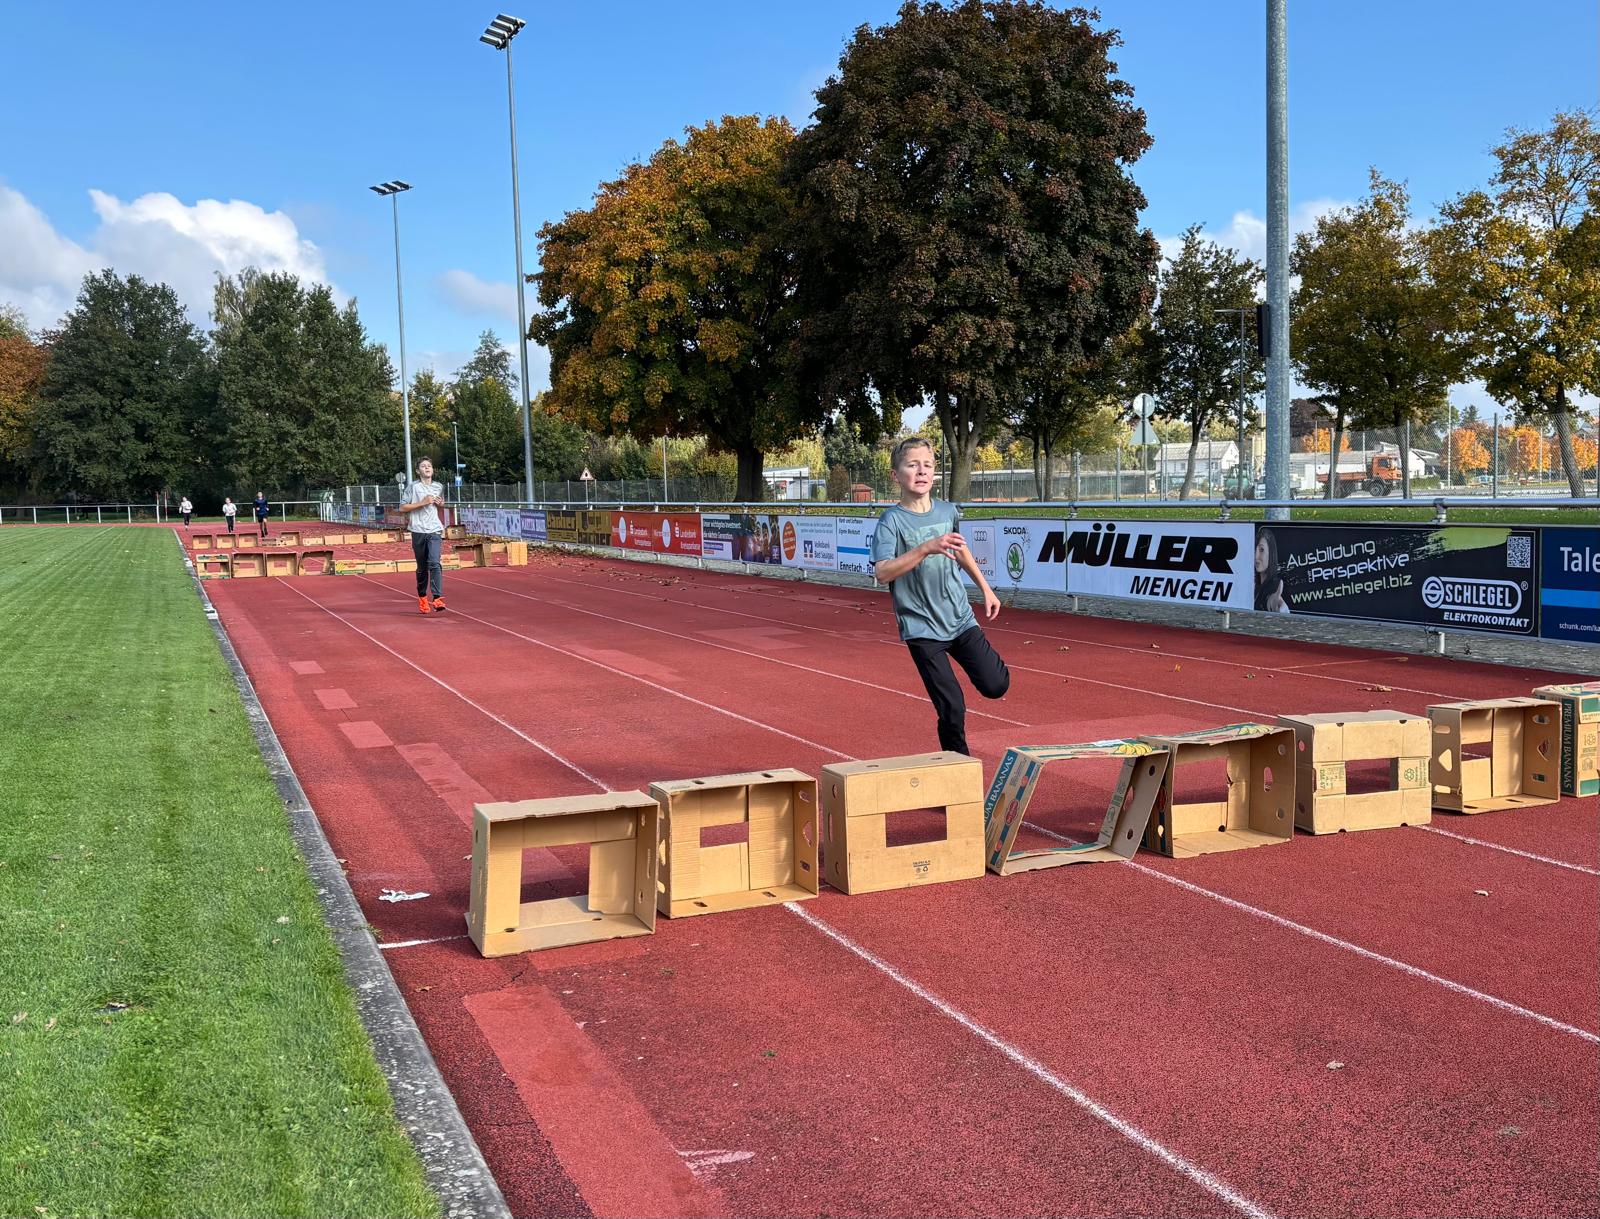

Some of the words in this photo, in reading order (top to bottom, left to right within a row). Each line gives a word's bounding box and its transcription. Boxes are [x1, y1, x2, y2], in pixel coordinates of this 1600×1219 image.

[1037, 523, 1239, 574] MÜLLER
[1287, 540, 1376, 569] Ausbildung
[840, 561, 862, 573] Ennetach
[1312, 553, 1409, 582] Perspektive
[1129, 575, 1233, 602] MENGEN
[1291, 574, 1413, 604] www.schlegel.biz
[1445, 584, 1512, 608] SCHLEGEL
[1443, 611, 1530, 628] ELEKTROKONTAKT
[1563, 703, 1572, 745] PREMIUM
[990, 756, 1014, 801] BANANAS
[1563, 746, 1572, 789] BANANAS
